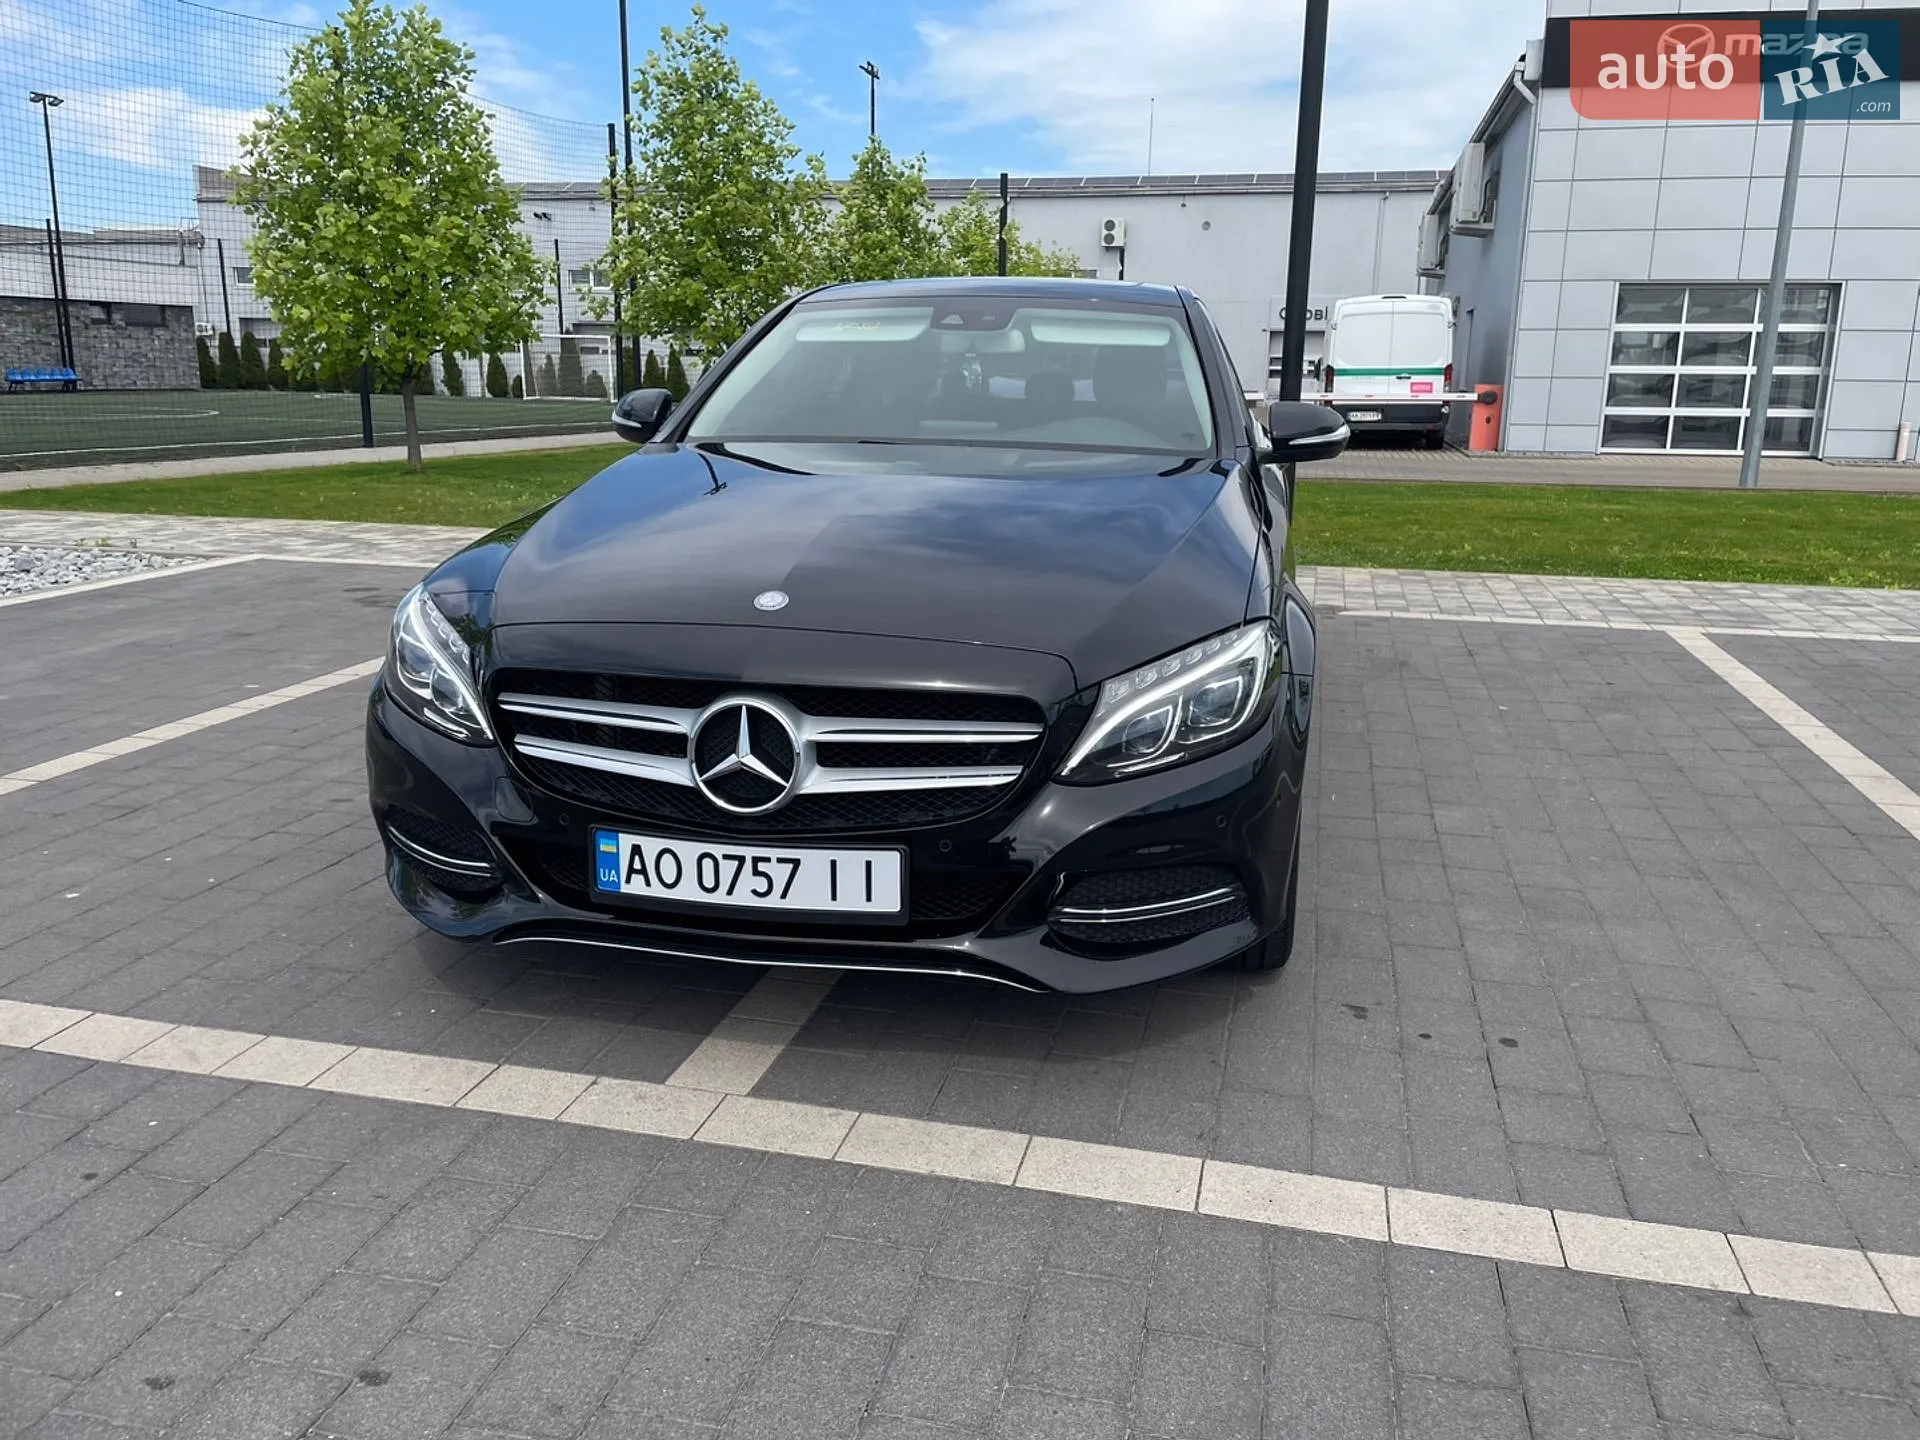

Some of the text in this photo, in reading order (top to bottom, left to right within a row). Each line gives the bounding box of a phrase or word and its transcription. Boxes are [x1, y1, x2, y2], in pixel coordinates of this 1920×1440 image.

[600, 868, 618, 883] UA
[624, 843, 683, 890] AO
[696, 851, 801, 900] 0757
